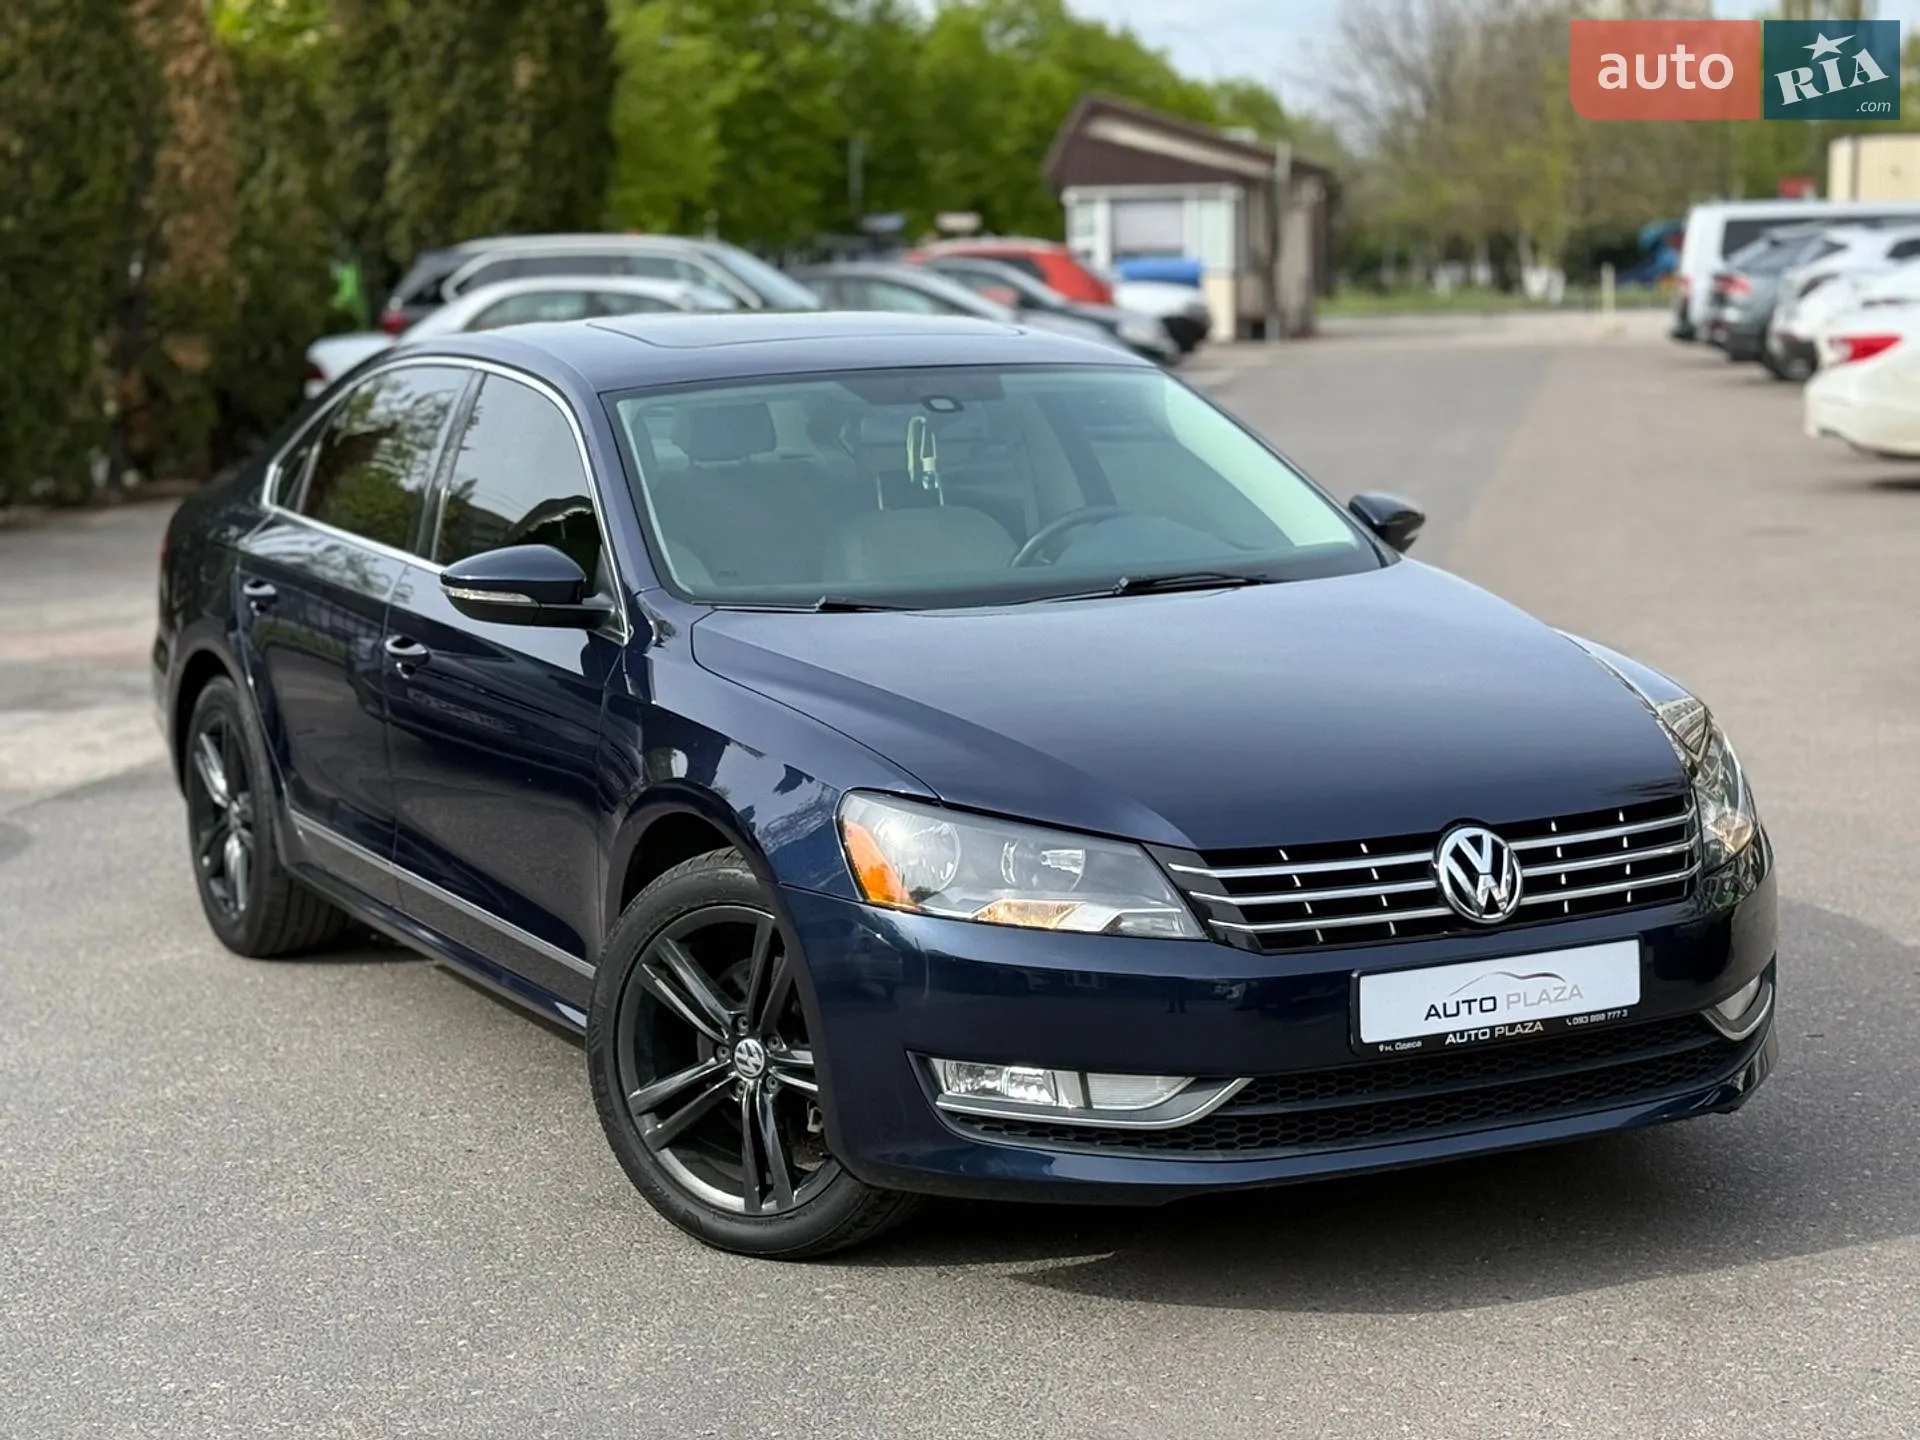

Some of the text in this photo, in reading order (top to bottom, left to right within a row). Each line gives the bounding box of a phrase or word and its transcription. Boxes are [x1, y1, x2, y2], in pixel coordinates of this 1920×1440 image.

[1423, 984, 1584, 1022] AUTO PLAZA
[1444, 1021, 1544, 1046] AUTO PLAZA
